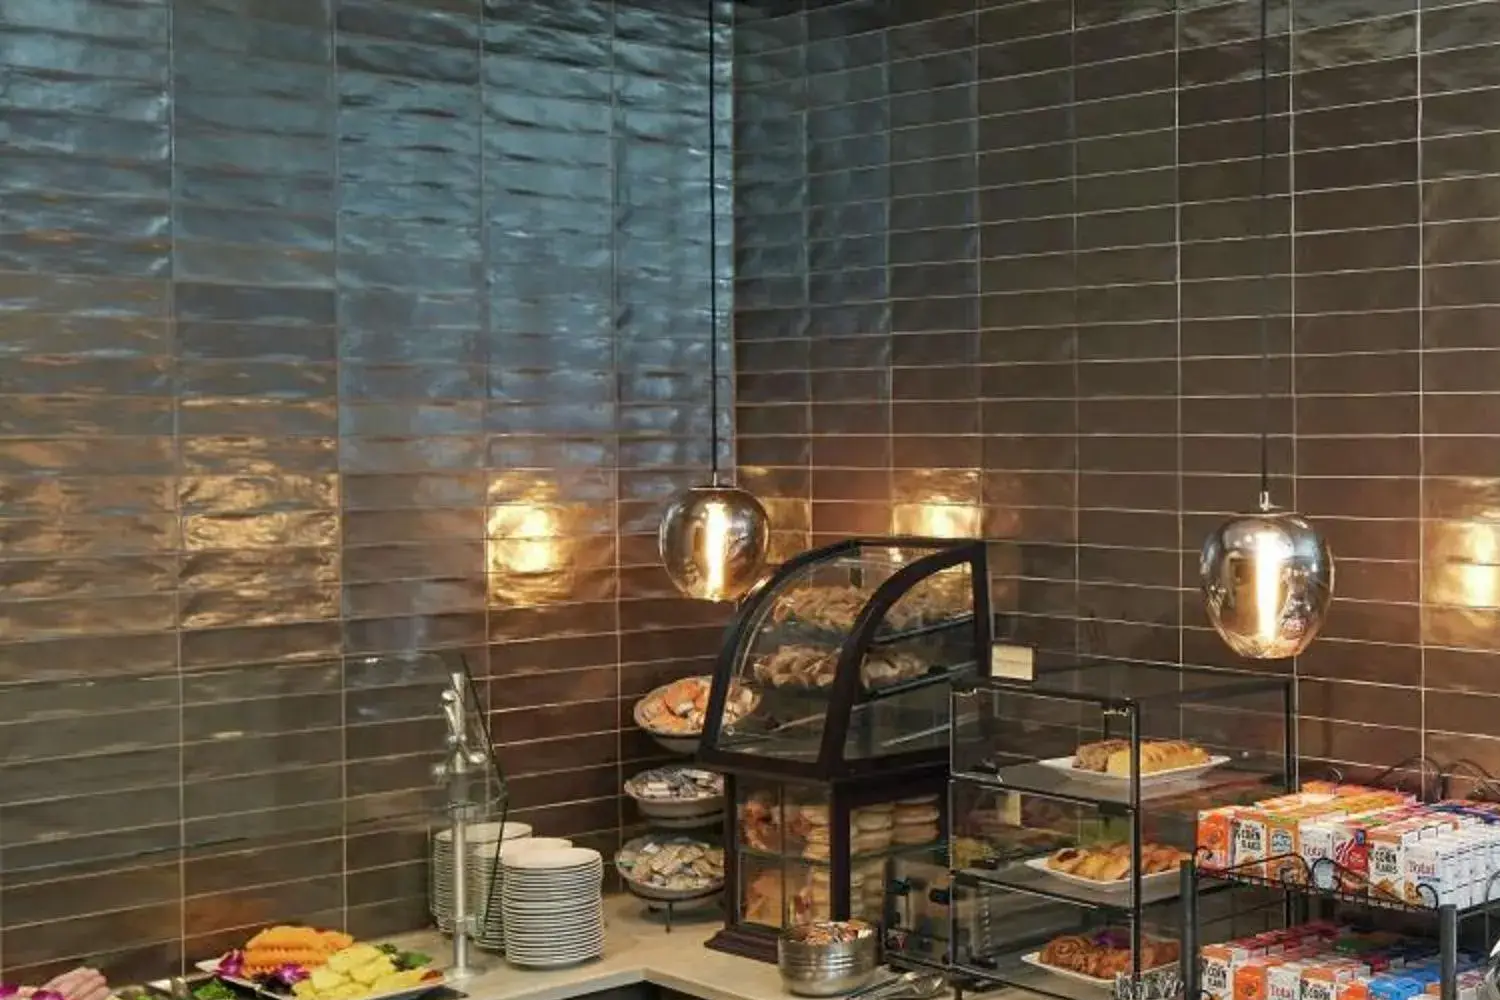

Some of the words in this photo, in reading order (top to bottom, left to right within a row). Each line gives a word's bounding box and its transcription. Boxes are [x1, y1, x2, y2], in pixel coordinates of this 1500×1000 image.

[1375, 850, 1397, 863] CORN
[1408, 859, 1436, 876] Total
[1270, 984, 1295, 1000] Total
[1309, 986, 1331, 1000] CORN
